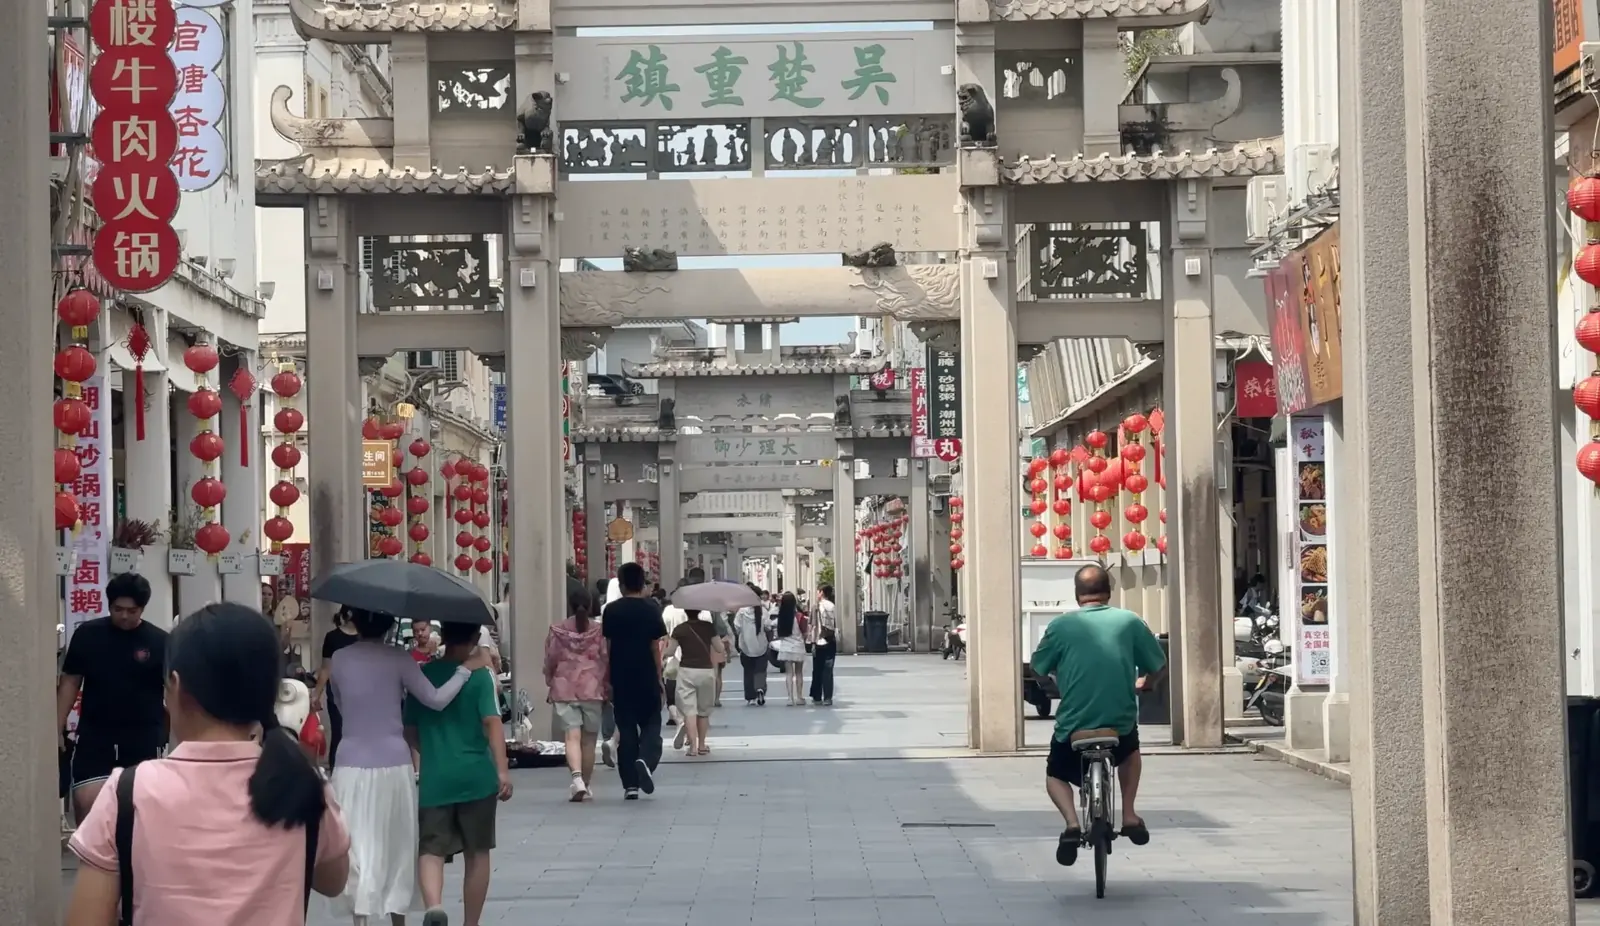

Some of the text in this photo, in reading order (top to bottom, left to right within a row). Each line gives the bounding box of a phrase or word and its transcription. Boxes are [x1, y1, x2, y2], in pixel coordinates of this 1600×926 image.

[109, 0, 160, 278] 楼牛肉火锅
[940, 438, 958, 458] 丸
